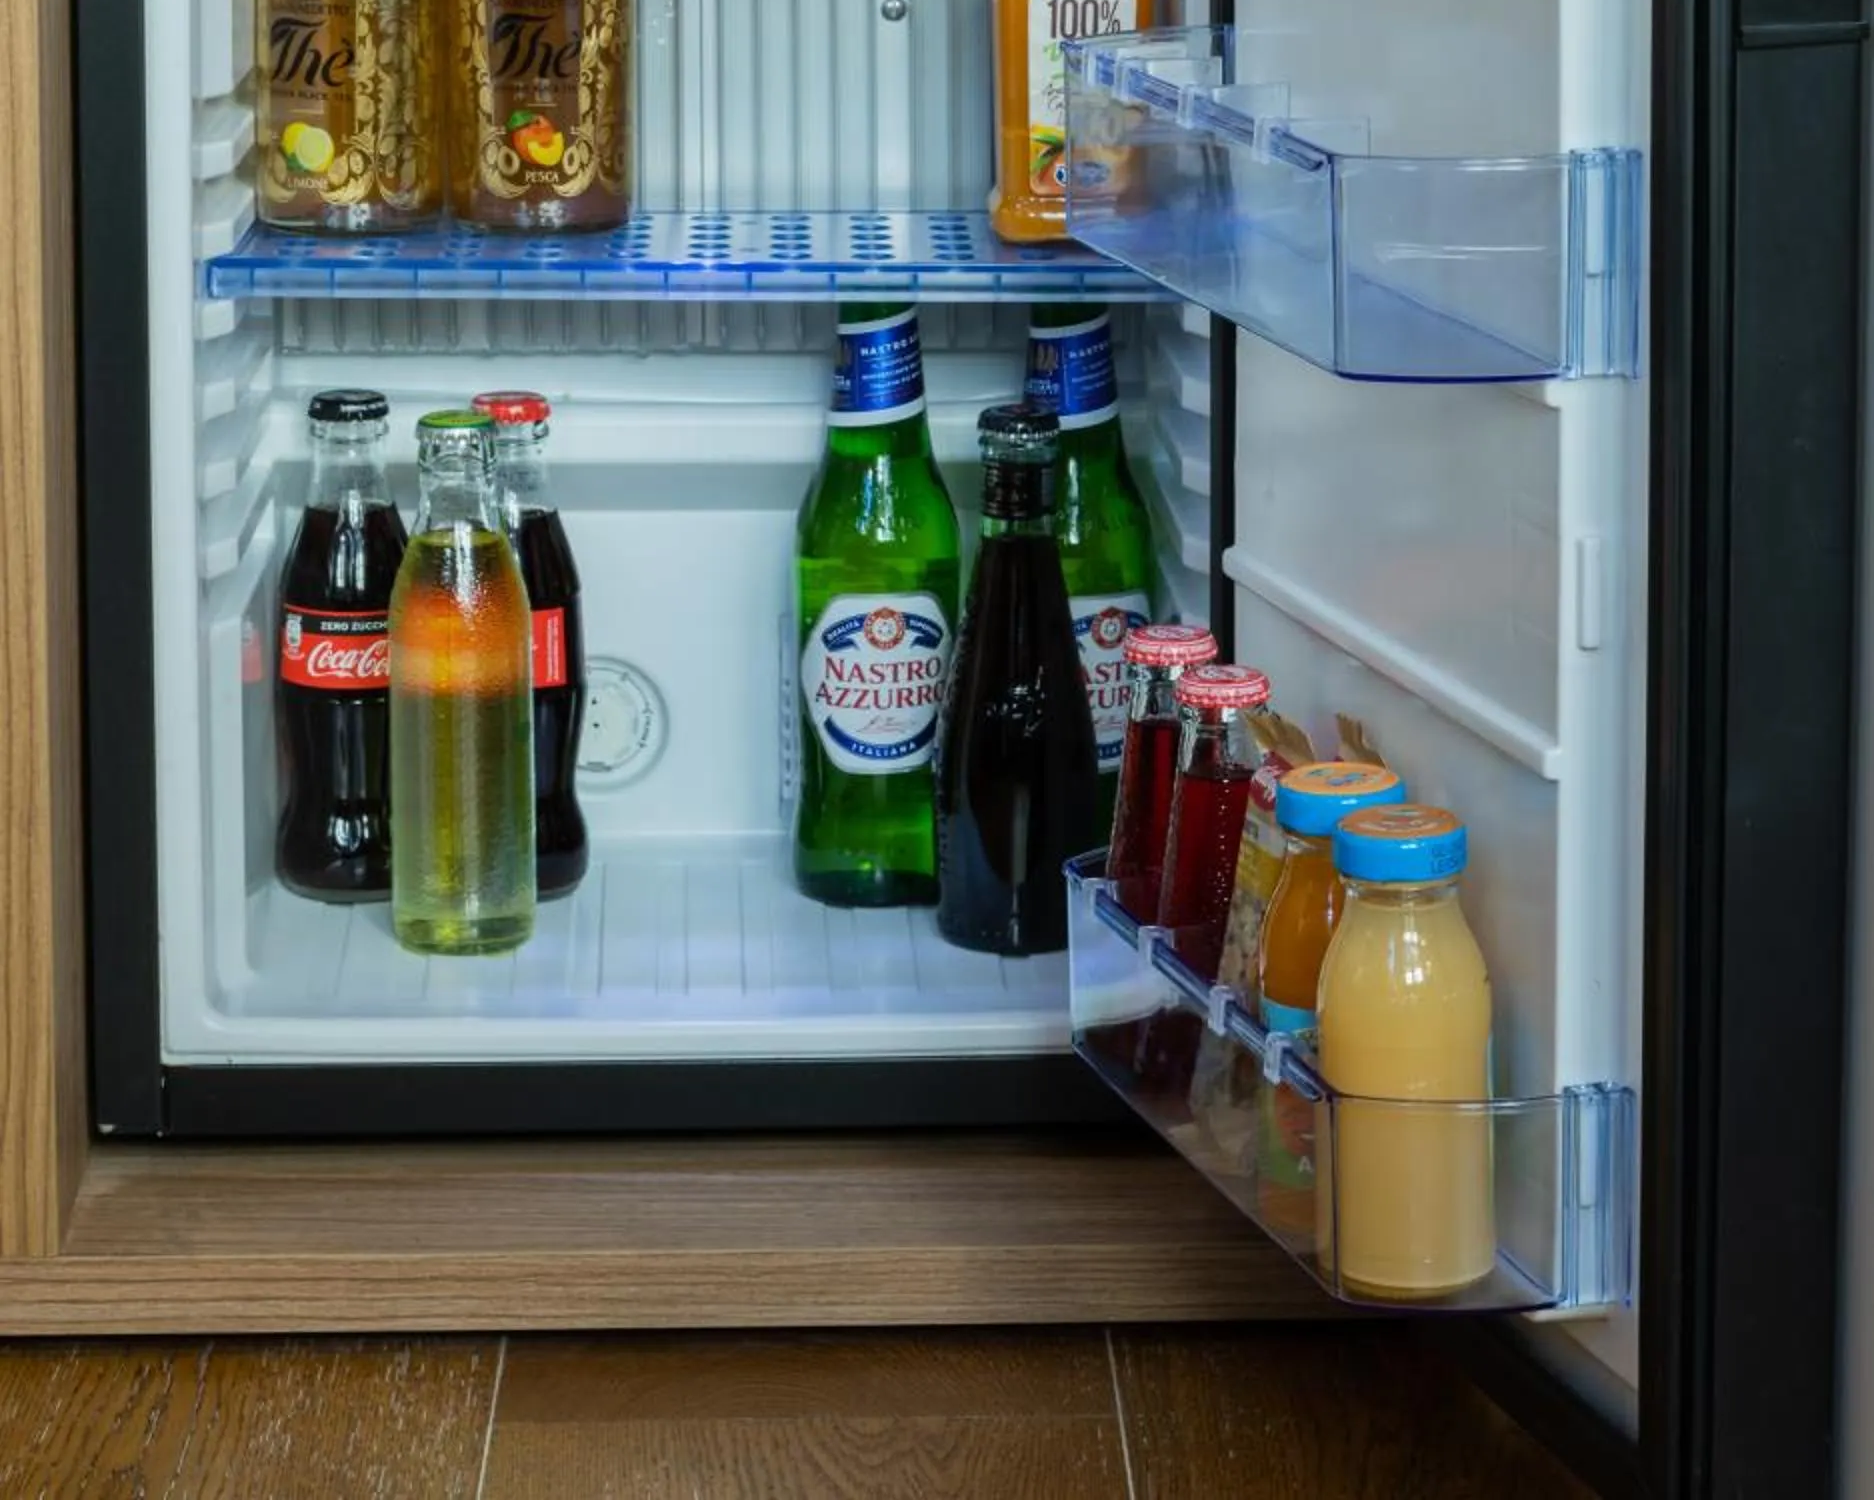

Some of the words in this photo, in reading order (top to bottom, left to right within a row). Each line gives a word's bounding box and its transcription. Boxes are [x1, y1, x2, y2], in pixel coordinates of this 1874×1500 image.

[525, 171, 559, 183] PESCA
[321, 621, 349, 631] ZERO
[825, 656, 941, 684] NASTRO
[851, 741, 917, 757] ITALIANA
